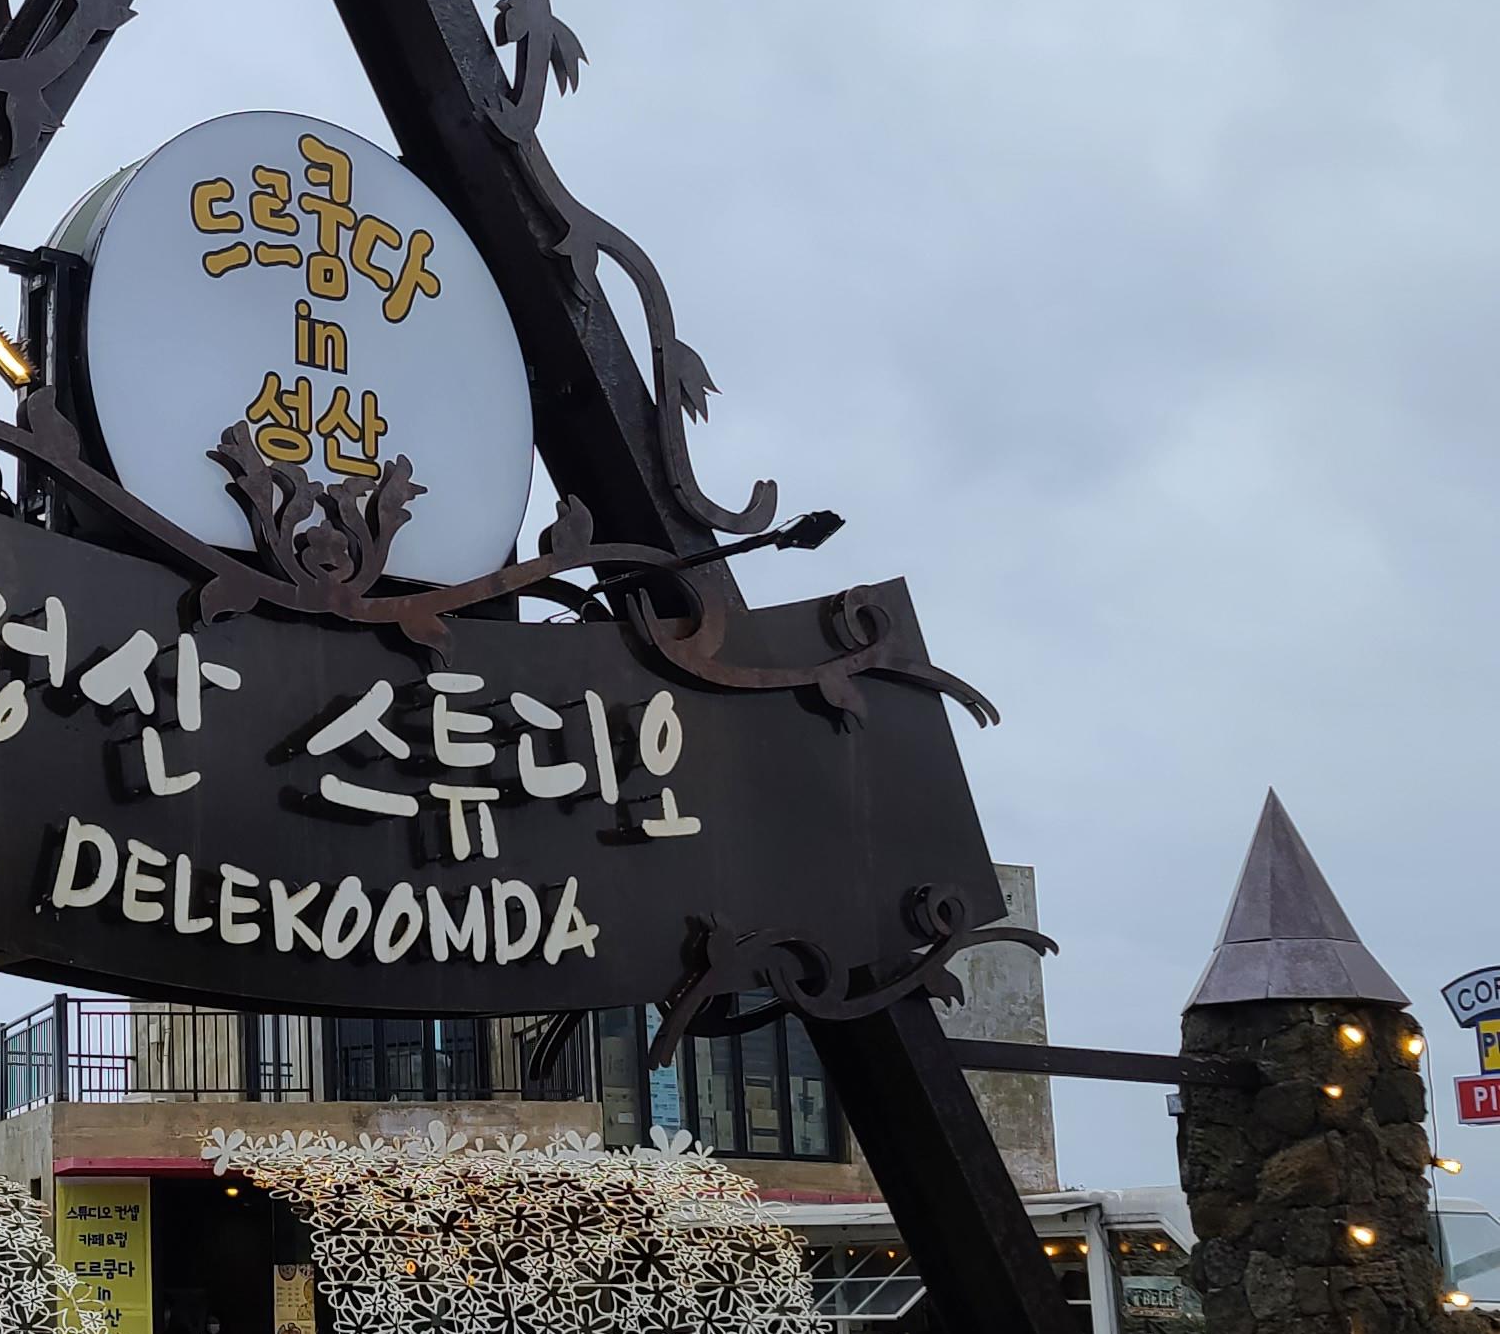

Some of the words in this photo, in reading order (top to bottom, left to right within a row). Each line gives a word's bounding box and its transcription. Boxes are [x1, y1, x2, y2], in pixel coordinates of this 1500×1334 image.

[192, 134, 441, 323] 드르쿰다
[294, 299, 348, 375] in
[246, 372, 388, 479] 성산
[306, 673, 701, 861] 스튜디오
[53, 816, 600, 966] DELEKOOMDA
[1474, 1085, 1500, 1112] PI
[66, 1205, 112, 1220] 스튜디오
[115, 1205, 140, 1221] 컨셉
[78, 1233, 104, 1246] 카페
[97, 1286, 111, 1301] in
